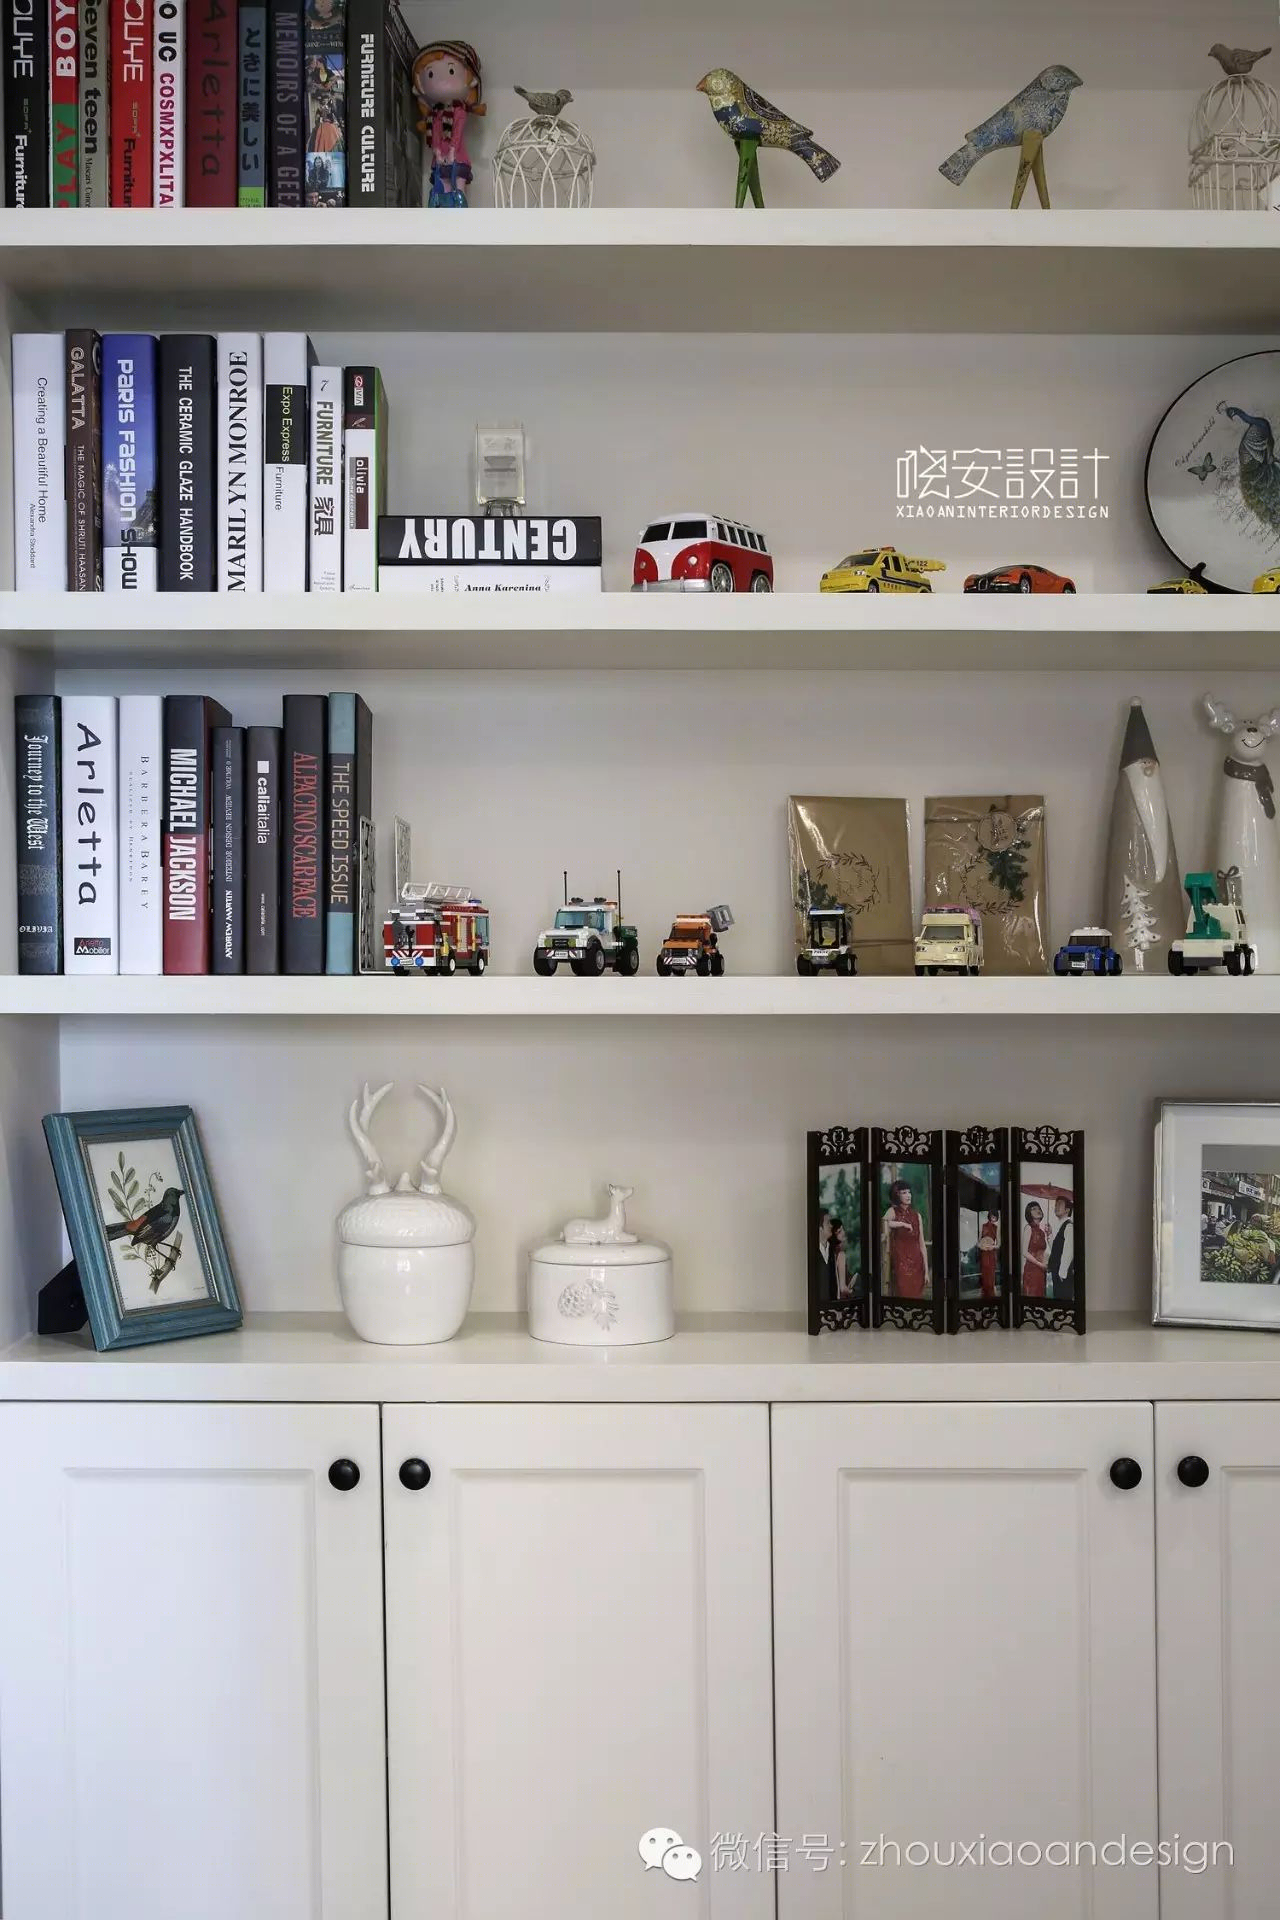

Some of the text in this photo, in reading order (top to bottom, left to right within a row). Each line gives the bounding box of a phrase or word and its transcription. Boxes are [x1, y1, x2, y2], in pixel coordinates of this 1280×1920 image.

[55, 0, 76, 77] BOY
[275, 12, 299, 103] MEMOIRS
[84, 88, 101, 154] teen
[276, 114, 297, 136] OF
[361, 34, 375, 193] FURNITURE CULTURE
[35, 376, 48, 424] Creating
[70, 347, 86, 430] GALATTA
[117, 359, 136, 424] PARIS
[281, 386, 293, 462] Expo Express
[316, 401, 334, 485] FURNITURE
[38, 438, 49, 487] Beautiful
[178, 366, 194, 581] THE CERAMIC GLAZE HANDBOOK
[227, 351, 248, 592] MARILYN MONROE
[275, 466, 285, 511] Furniture
[356, 459, 369, 494] olivia
[38, 489, 47, 523] Home
[77, 445, 88, 592] THE MAGIC OF SHRUTI HAASAN
[398, 518, 577, 560] CENTURY
[120, 528, 138, 590] SHOW
[464, 583, 542, 592] Anna Karenina
[23, 734, 48, 782] Journey
[27, 817, 48, 850] West
[77, 722, 104, 905] Arletta
[168, 748, 197, 921] MICHAEL JACKSON
[257, 777, 271, 844] caliaitalia
[331, 762, 349, 904] THE SPEED ISSUE
[225, 850, 233, 882] INTERIOR
[292, 834, 317, 918] SCARFACE
[225, 920, 233, 959] ANDREW
